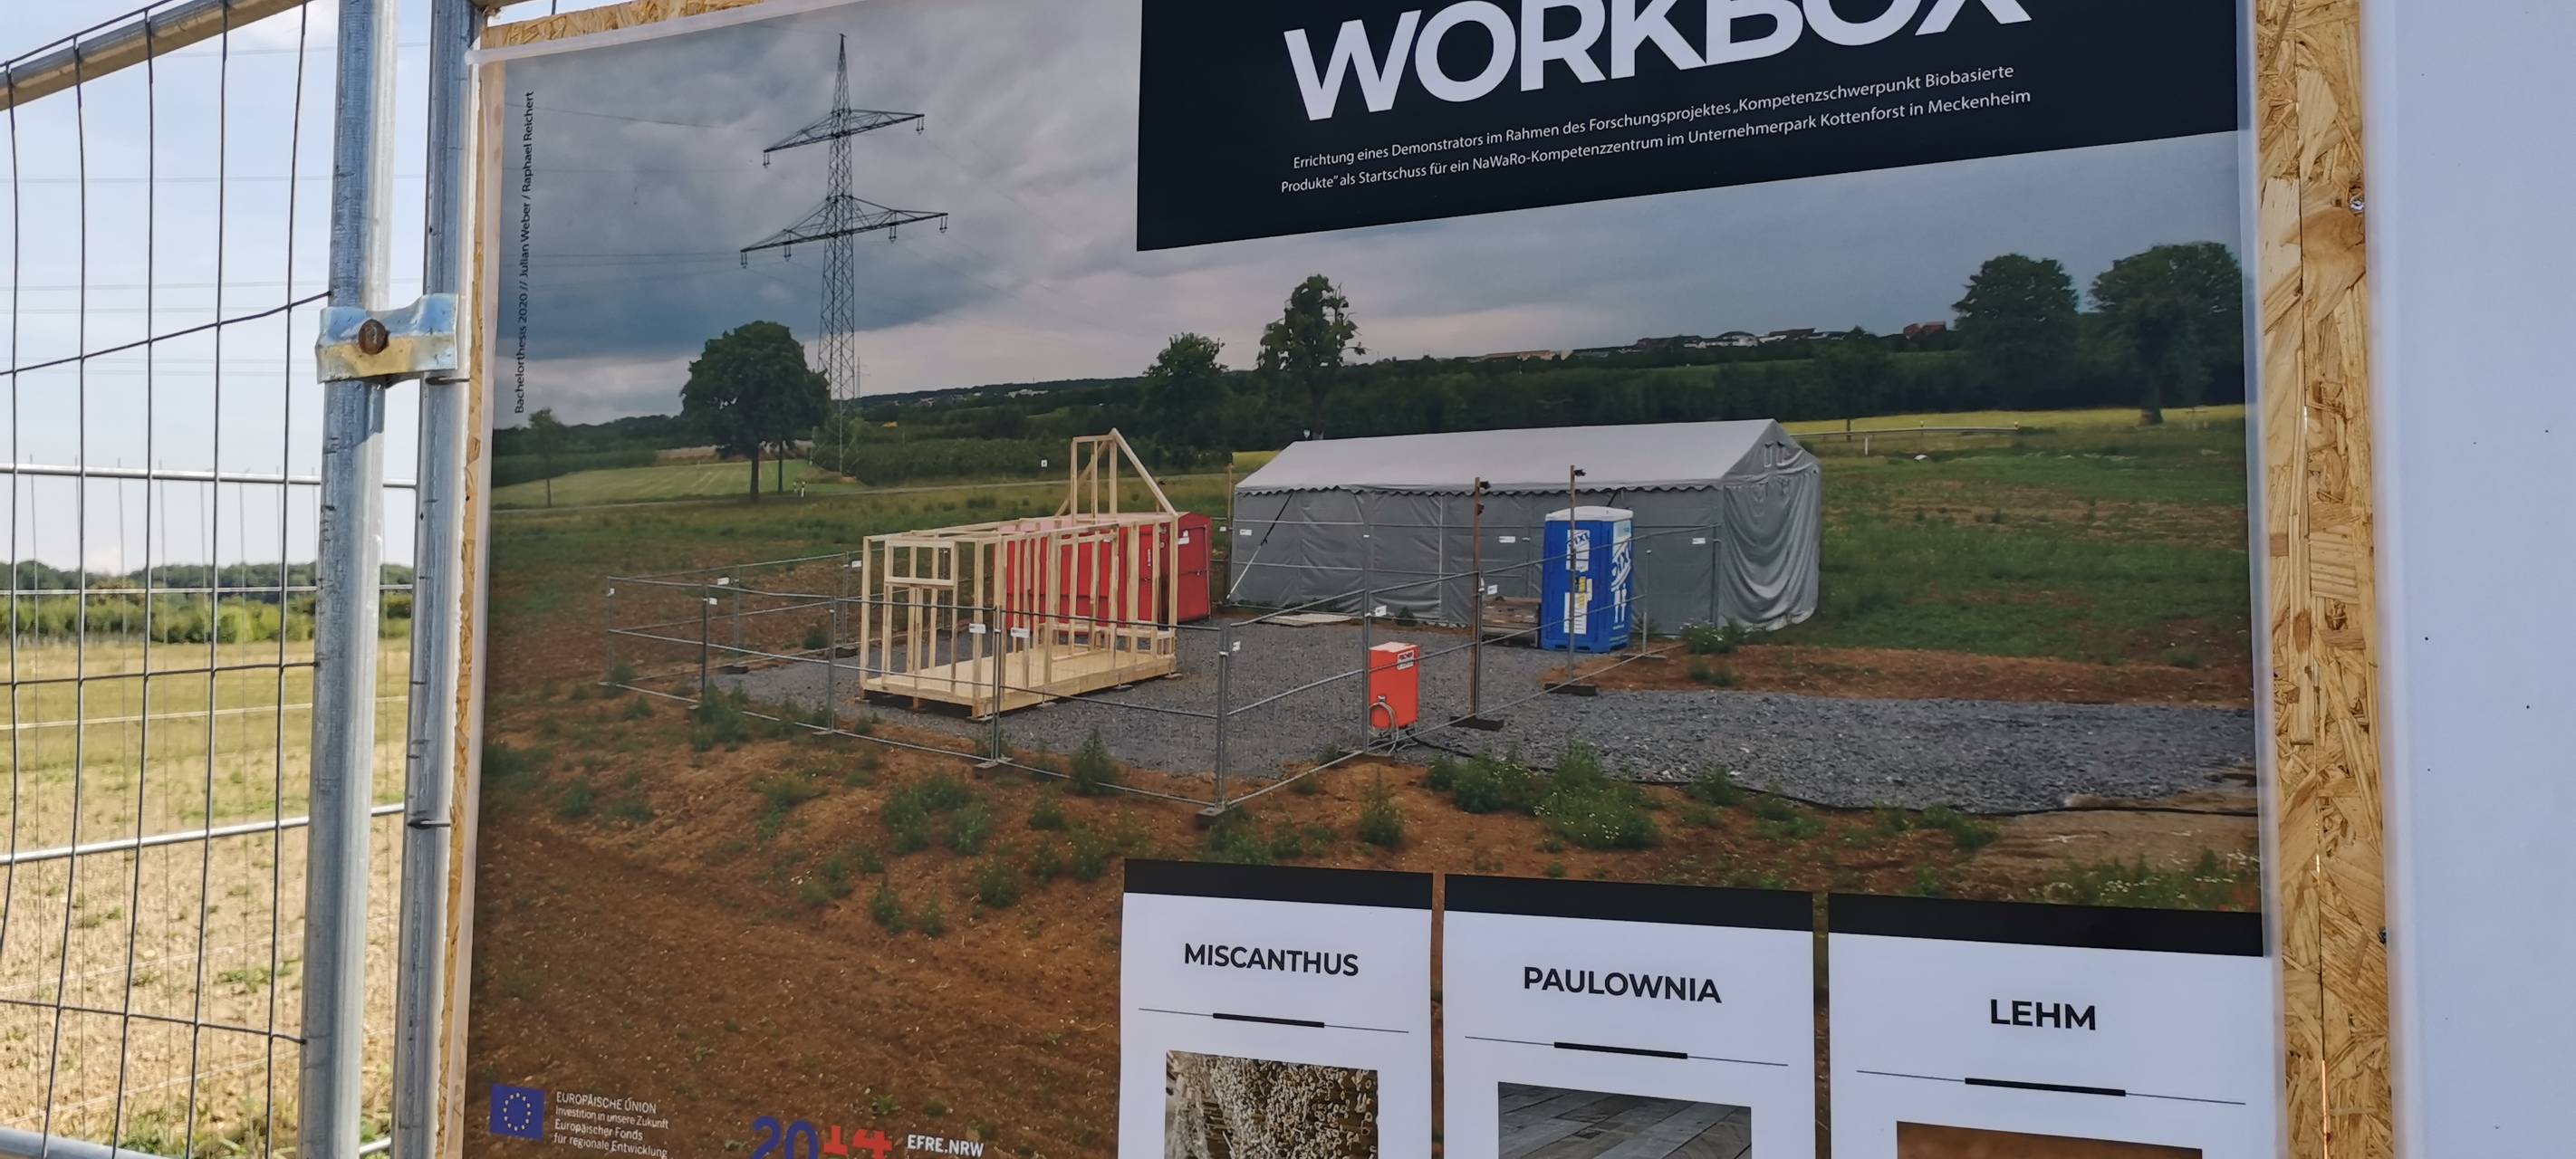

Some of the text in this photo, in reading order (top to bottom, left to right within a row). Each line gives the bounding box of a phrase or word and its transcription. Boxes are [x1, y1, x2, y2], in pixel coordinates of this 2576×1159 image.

[523, 91, 534, 142] Reichert
[1293, 151, 1355, 170] Errichtung
[1357, 148, 1389, 161] eines
[1391, 136, 1484, 157] Demonstrators
[1486, 132, 1503, 145] im
[1505, 126, 1560, 142] Rahmen
[1562, 120, 1586, 135] des
[1589, 103, 1732, 131] Forschungsprojektes
[1925, 66, 2014, 94] Biobasierte
[1339, 173, 1356, 187] als
[1359, 166, 1427, 184] Startschuss
[1429, 161, 1448, 176] für
[1449, 158, 1469, 173] ein
[1473, 138, 1663, 170] NaWaRo-Kompetenzzentrum
[1667, 133, 1685, 147] im
[1688, 115, 1817, 144] Unternehmerpark
[1821, 105, 1906, 127] Kottenforst
[1909, 102, 1924, 117] in
[1927, 91, 2031, 114] Meckenheim
[522, 144, 533, 193] Raphael
[521, 202, 532, 243] Weber
[519, 244, 531, 278] Julian
[518, 293, 528, 323] 2020
[514, 326, 528, 414] Bachelorthesis
[1184, 943, 1360, 978] MISCANTHUS
[1523, 966, 1723, 1005] PAULOWNIA
[1990, 999, 2097, 1032] LEHM
[555, 1106, 669, 1130] Investition in unsere Zukunft
[624, 1100, 657, 1115] UNION
[554, 1118, 644, 1141] Europäischer Fonds
[907, 1134, 985, 1158] EFRE.NRW
[569, 1135, 610, 1150] regionale
[610, 1140, 668, 1159] Entwicklung
